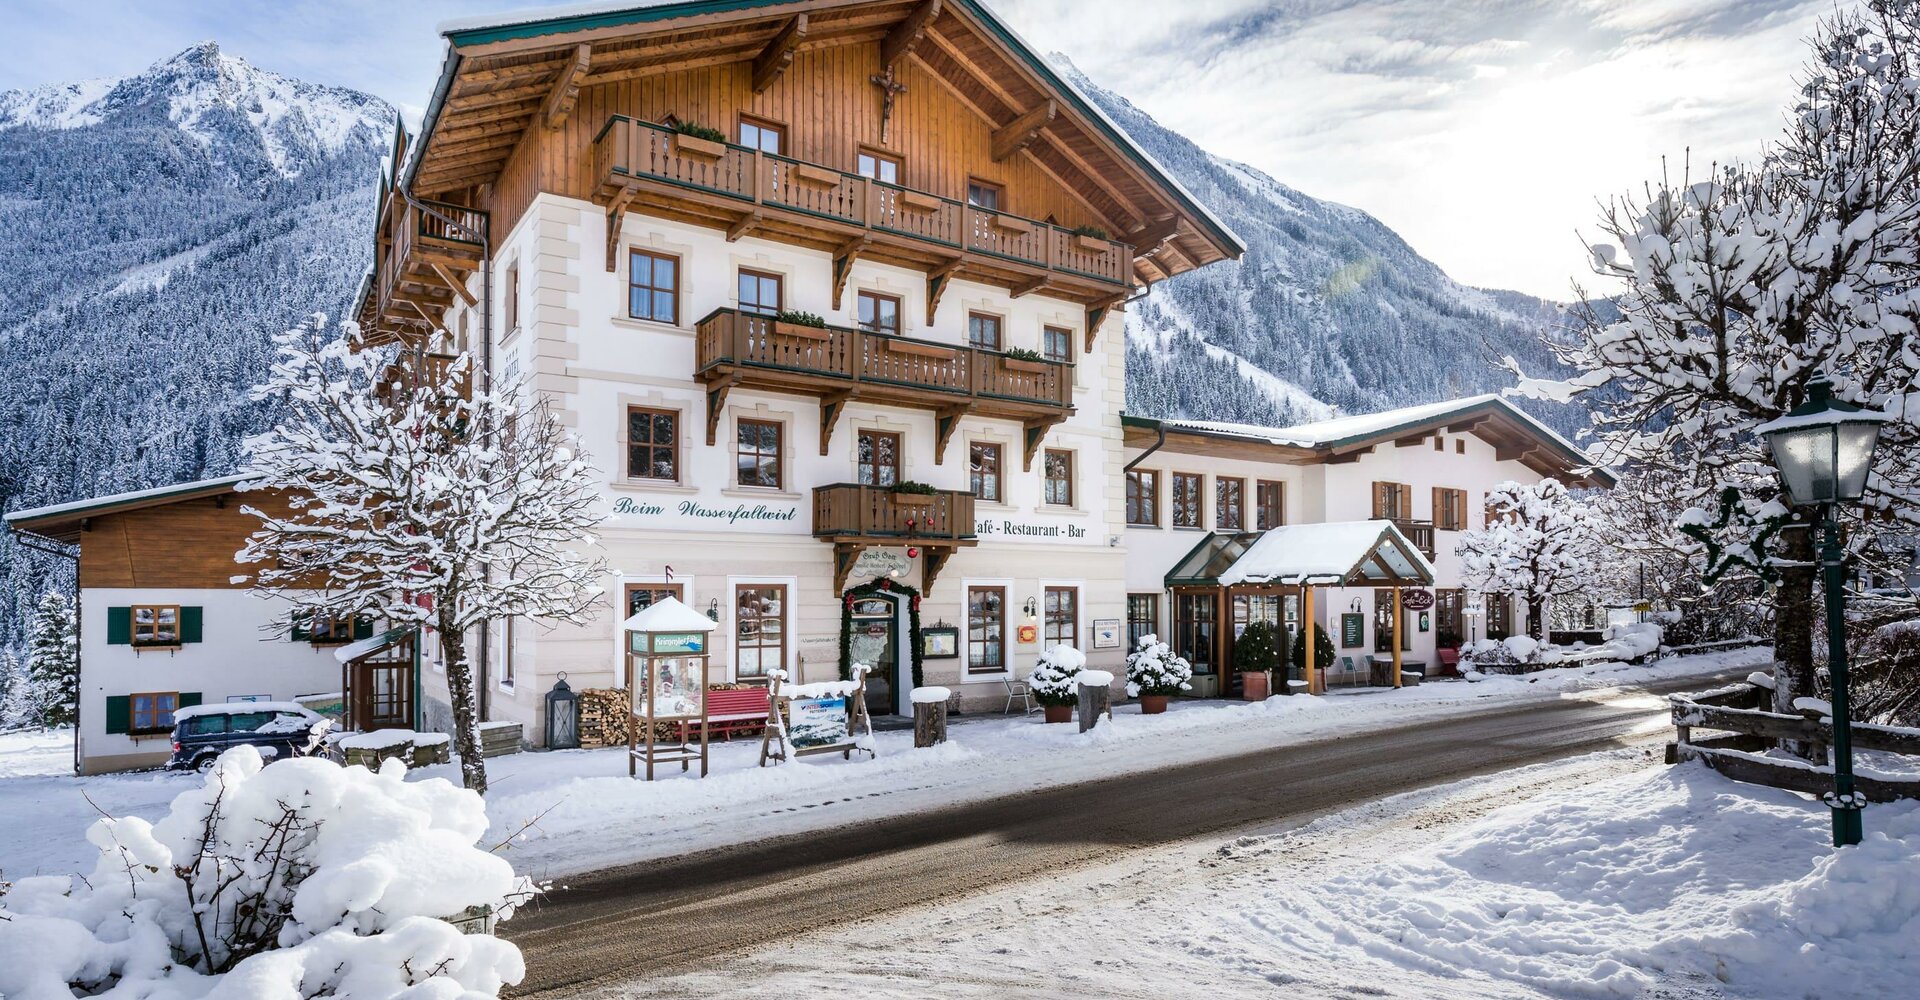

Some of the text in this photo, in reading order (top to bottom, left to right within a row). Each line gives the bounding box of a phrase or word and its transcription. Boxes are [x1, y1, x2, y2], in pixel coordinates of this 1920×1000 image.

[613, 497, 796, 524] Beim Wasserfallwirt
[975, 519, 993, 534] afé
[1004, 520, 1059, 537] Restaurant
[1068, 524, 1086, 538] Bar
